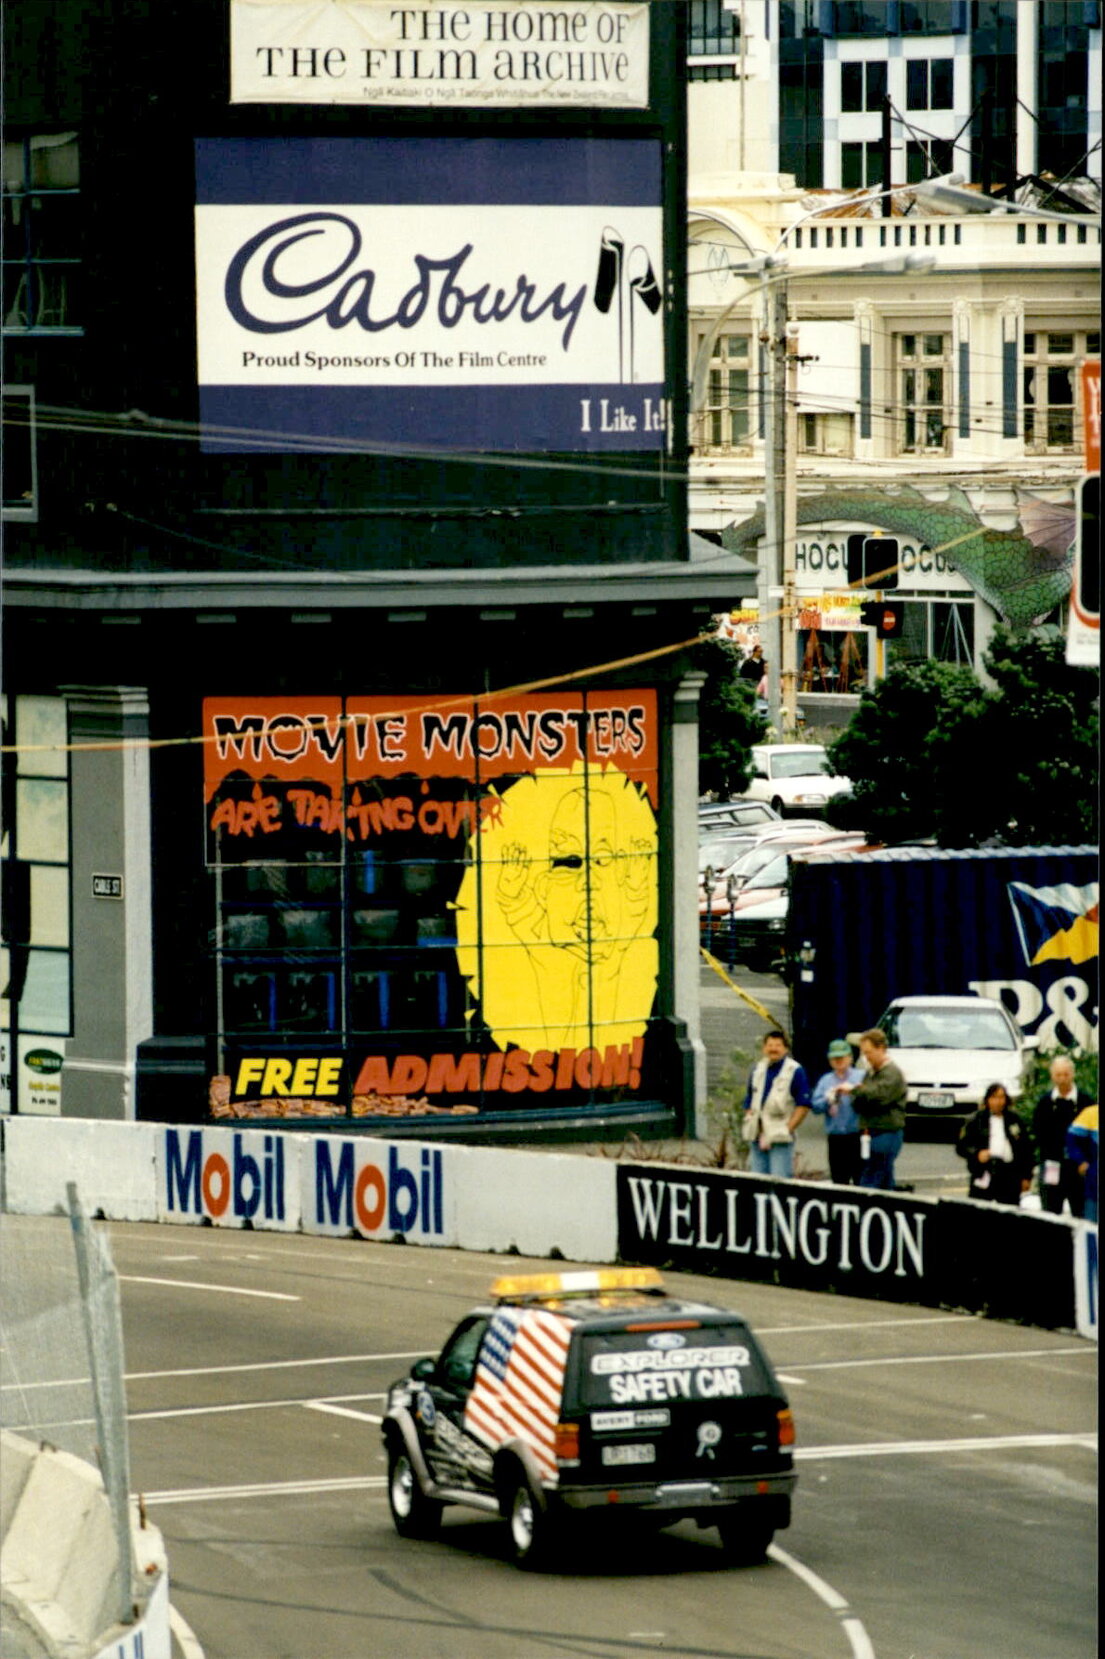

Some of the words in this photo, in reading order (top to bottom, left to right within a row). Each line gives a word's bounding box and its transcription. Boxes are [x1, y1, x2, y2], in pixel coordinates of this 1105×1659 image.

[597, 13, 630, 44] OF
[225, 212, 588, 352] Cadbury
[242, 351, 300, 367] Proud
[304, 351, 391, 370] Sponsors
[395, 351, 416, 367] Of
[420, 351, 454, 367] The
[458, 351, 494, 367] Film
[497, 351, 547, 367] Centre
[581, 399, 591, 432] I
[213, 713, 407, 763] MOVIE
[421, 706, 646, 763] MONSTERS
[210, 795, 283, 838] ARE
[286, 788, 415, 842] TAKING
[235, 1057, 344, 1097] FREE
[353, 1036, 645, 1096] ADMISSION!
[165, 1128, 286, 1222] Mobil
[315, 1138, 444, 1235] Mobil
[627, 1177, 927, 1279] WELLINGTON
[591, 1346, 750, 1375] EXPLORER
[609, 1369, 692, 1404] SAFETY
[696, 1367, 744, 1399] CAR
